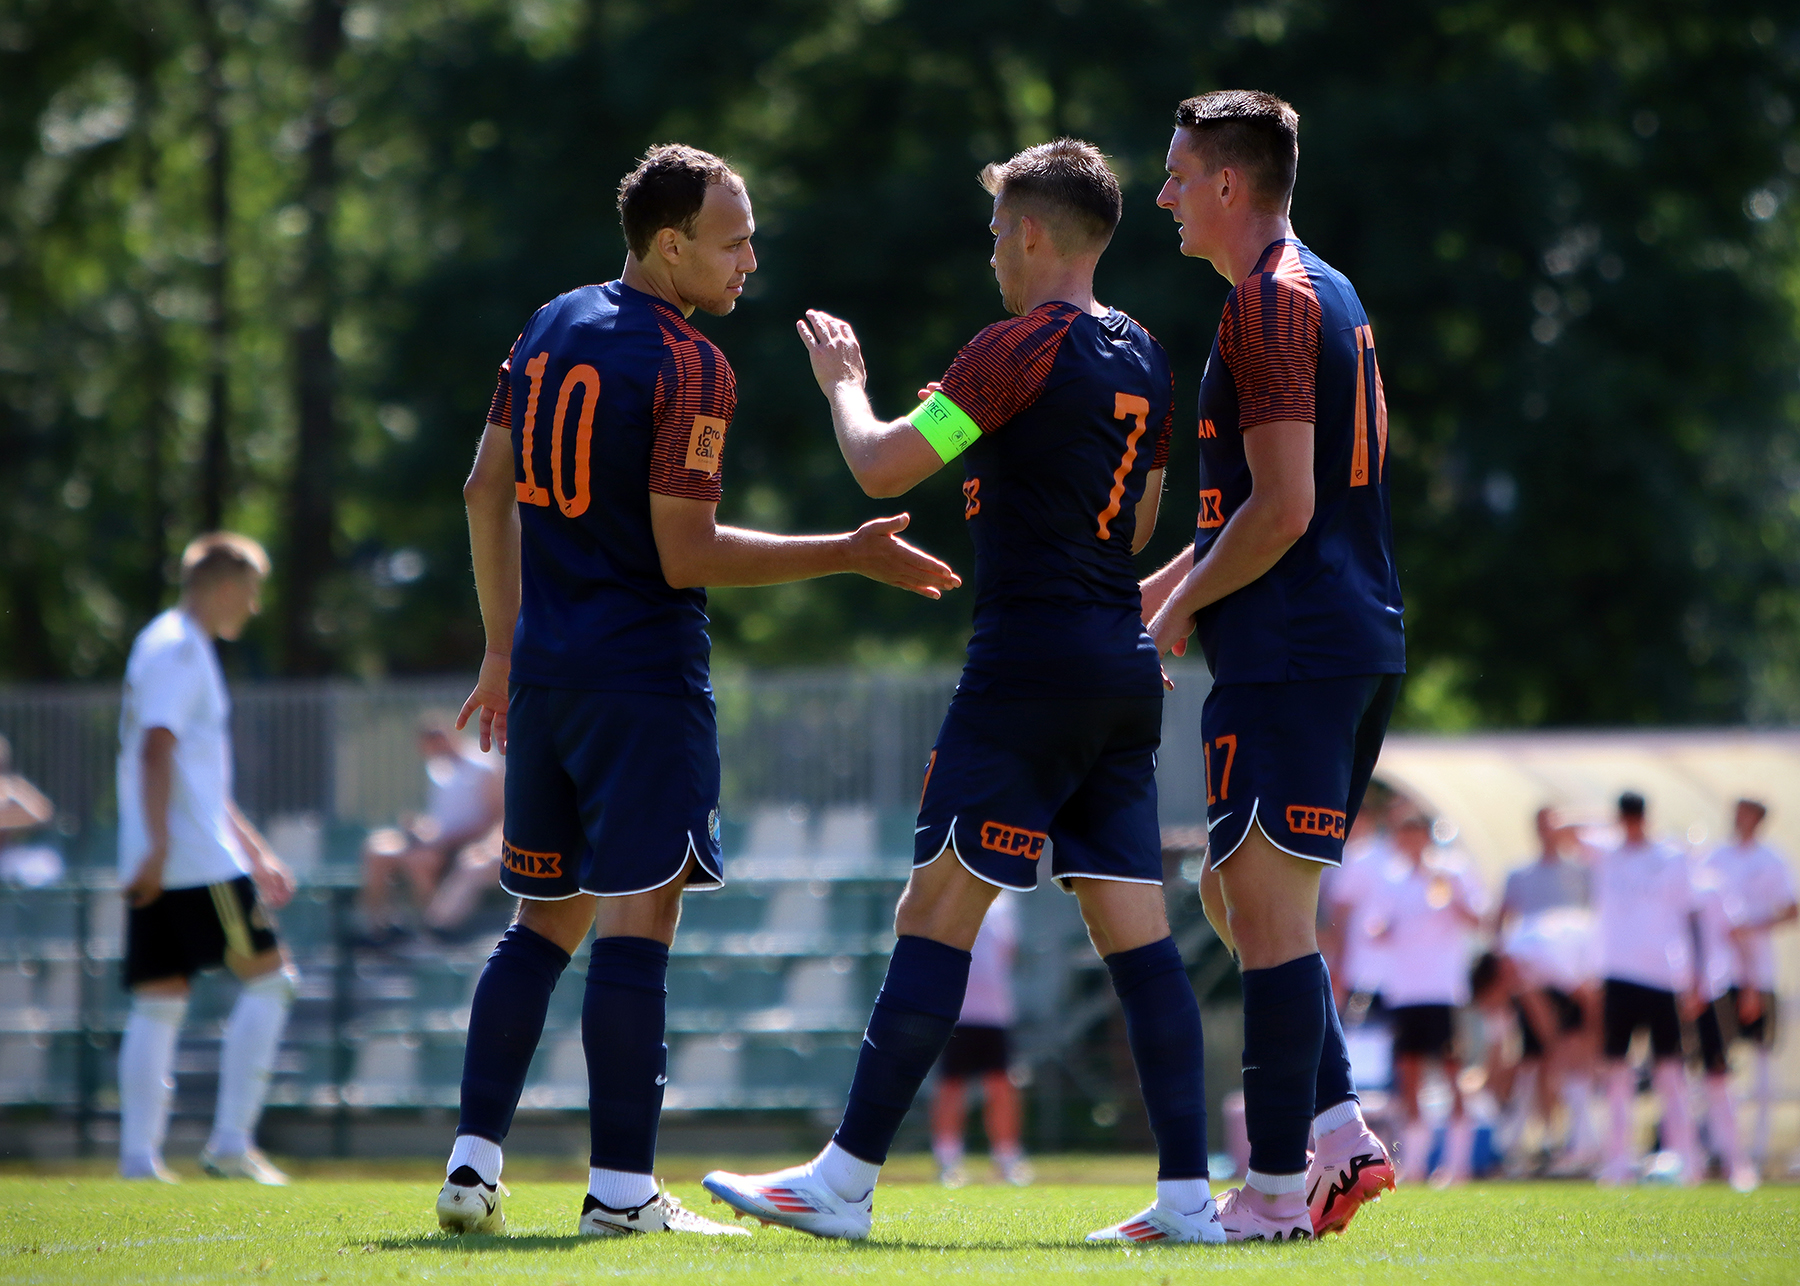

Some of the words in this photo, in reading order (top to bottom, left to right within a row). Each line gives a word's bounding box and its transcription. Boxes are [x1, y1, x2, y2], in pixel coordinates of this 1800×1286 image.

[515, 351, 600, 519] 10
[1096, 391, 1149, 540] 7
[1204, 733, 1238, 807] 17
